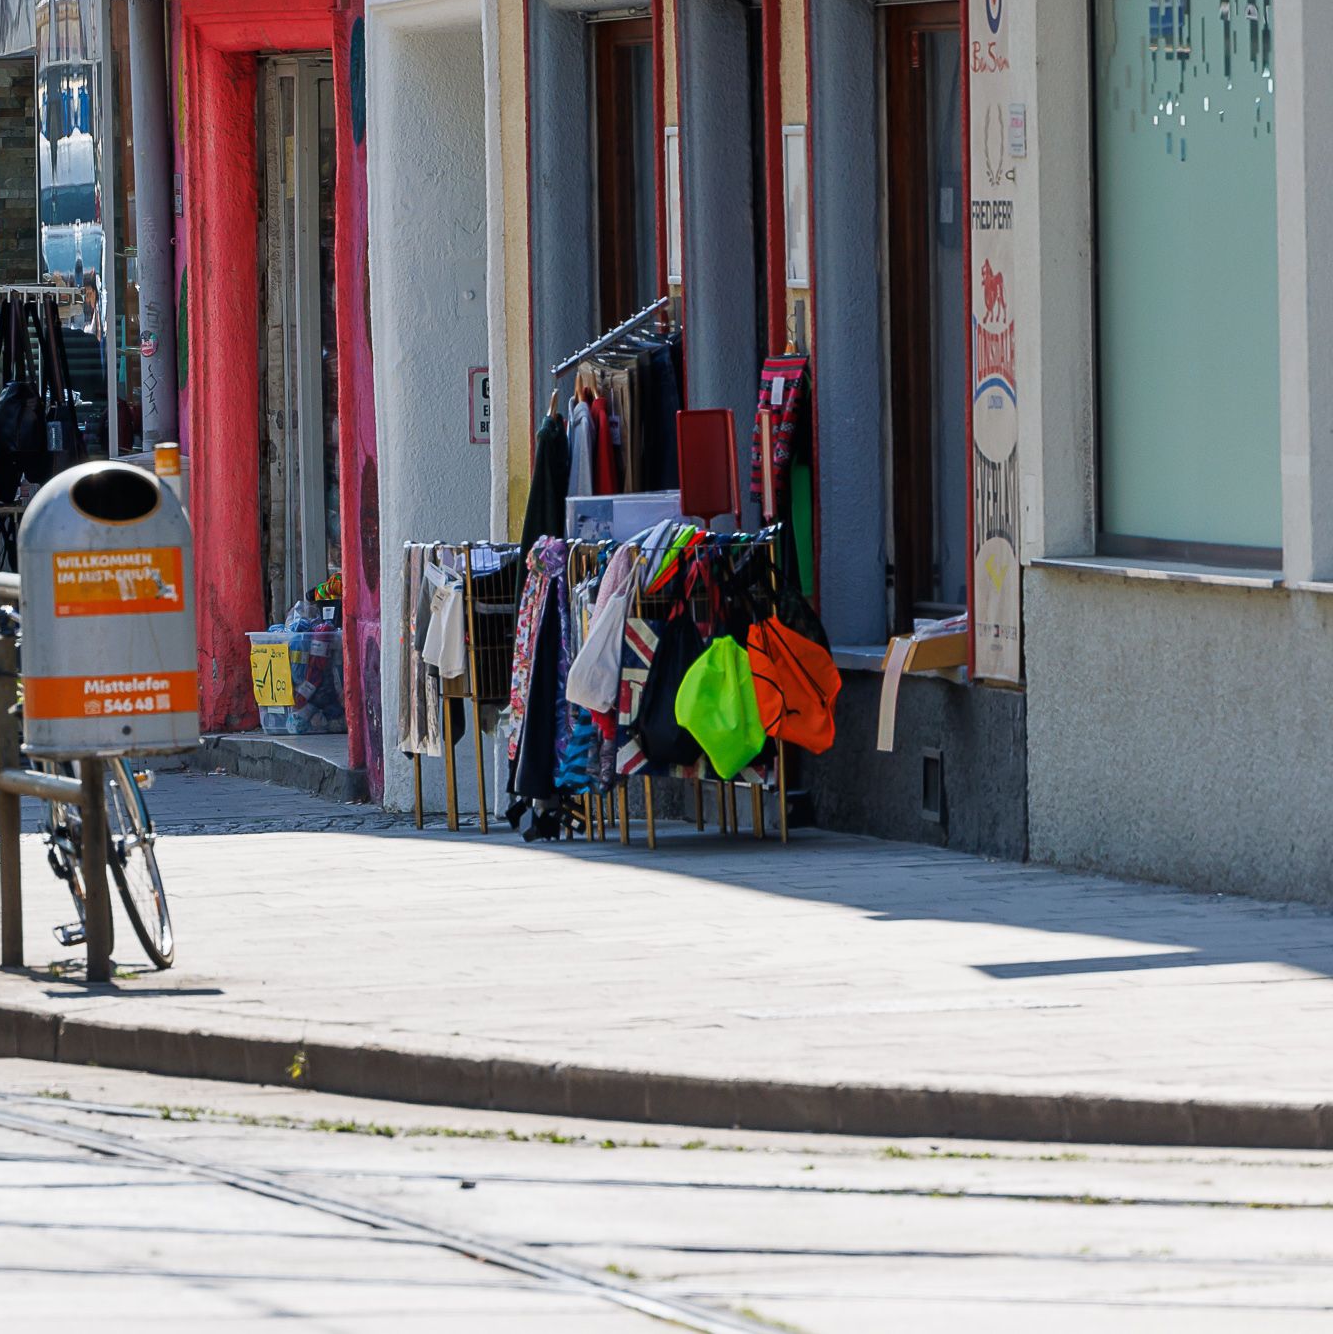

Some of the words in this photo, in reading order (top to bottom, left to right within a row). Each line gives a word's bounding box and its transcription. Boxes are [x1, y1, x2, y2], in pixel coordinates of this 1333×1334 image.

[56, 553, 153, 569] WILLKOMMEN
[57, 571, 76, 584] IM
[84, 676, 169, 694] Misttelefon
[104, 698, 133, 713] 546
[135, 696, 155, 711] 48
